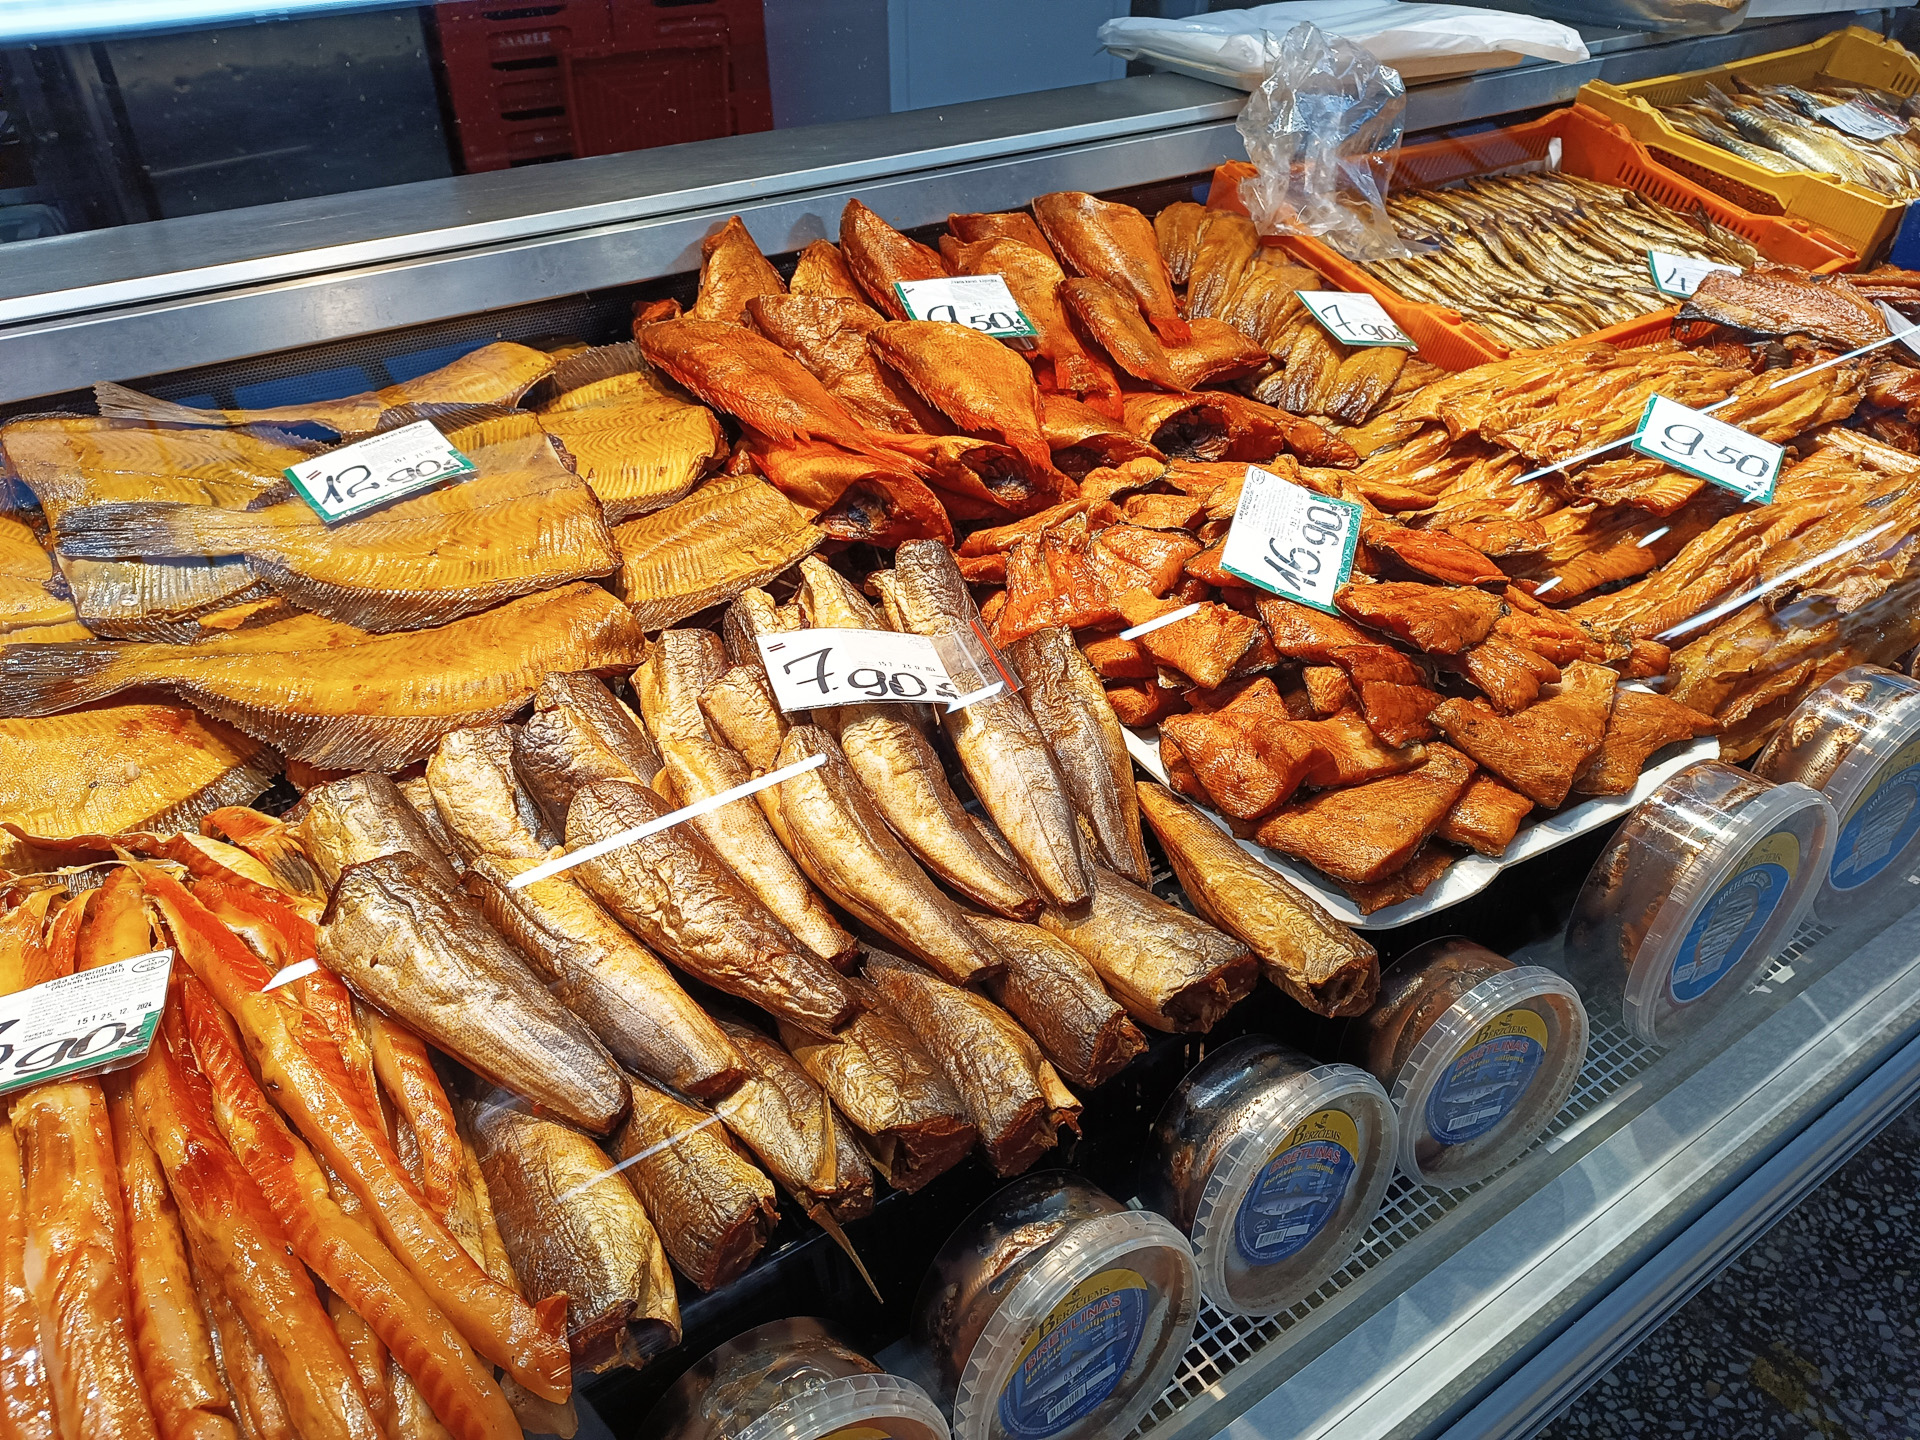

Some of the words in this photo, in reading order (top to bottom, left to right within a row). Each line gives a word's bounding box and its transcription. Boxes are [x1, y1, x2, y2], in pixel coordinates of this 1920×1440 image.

[1321, 305, 1396, 341] 7.90
[322, 460, 441, 505] 12.90
[1264, 506, 1342, 591] 16.90
[783, 648, 927, 697] 7.90
[0, 1018, 127, 1075] .90
